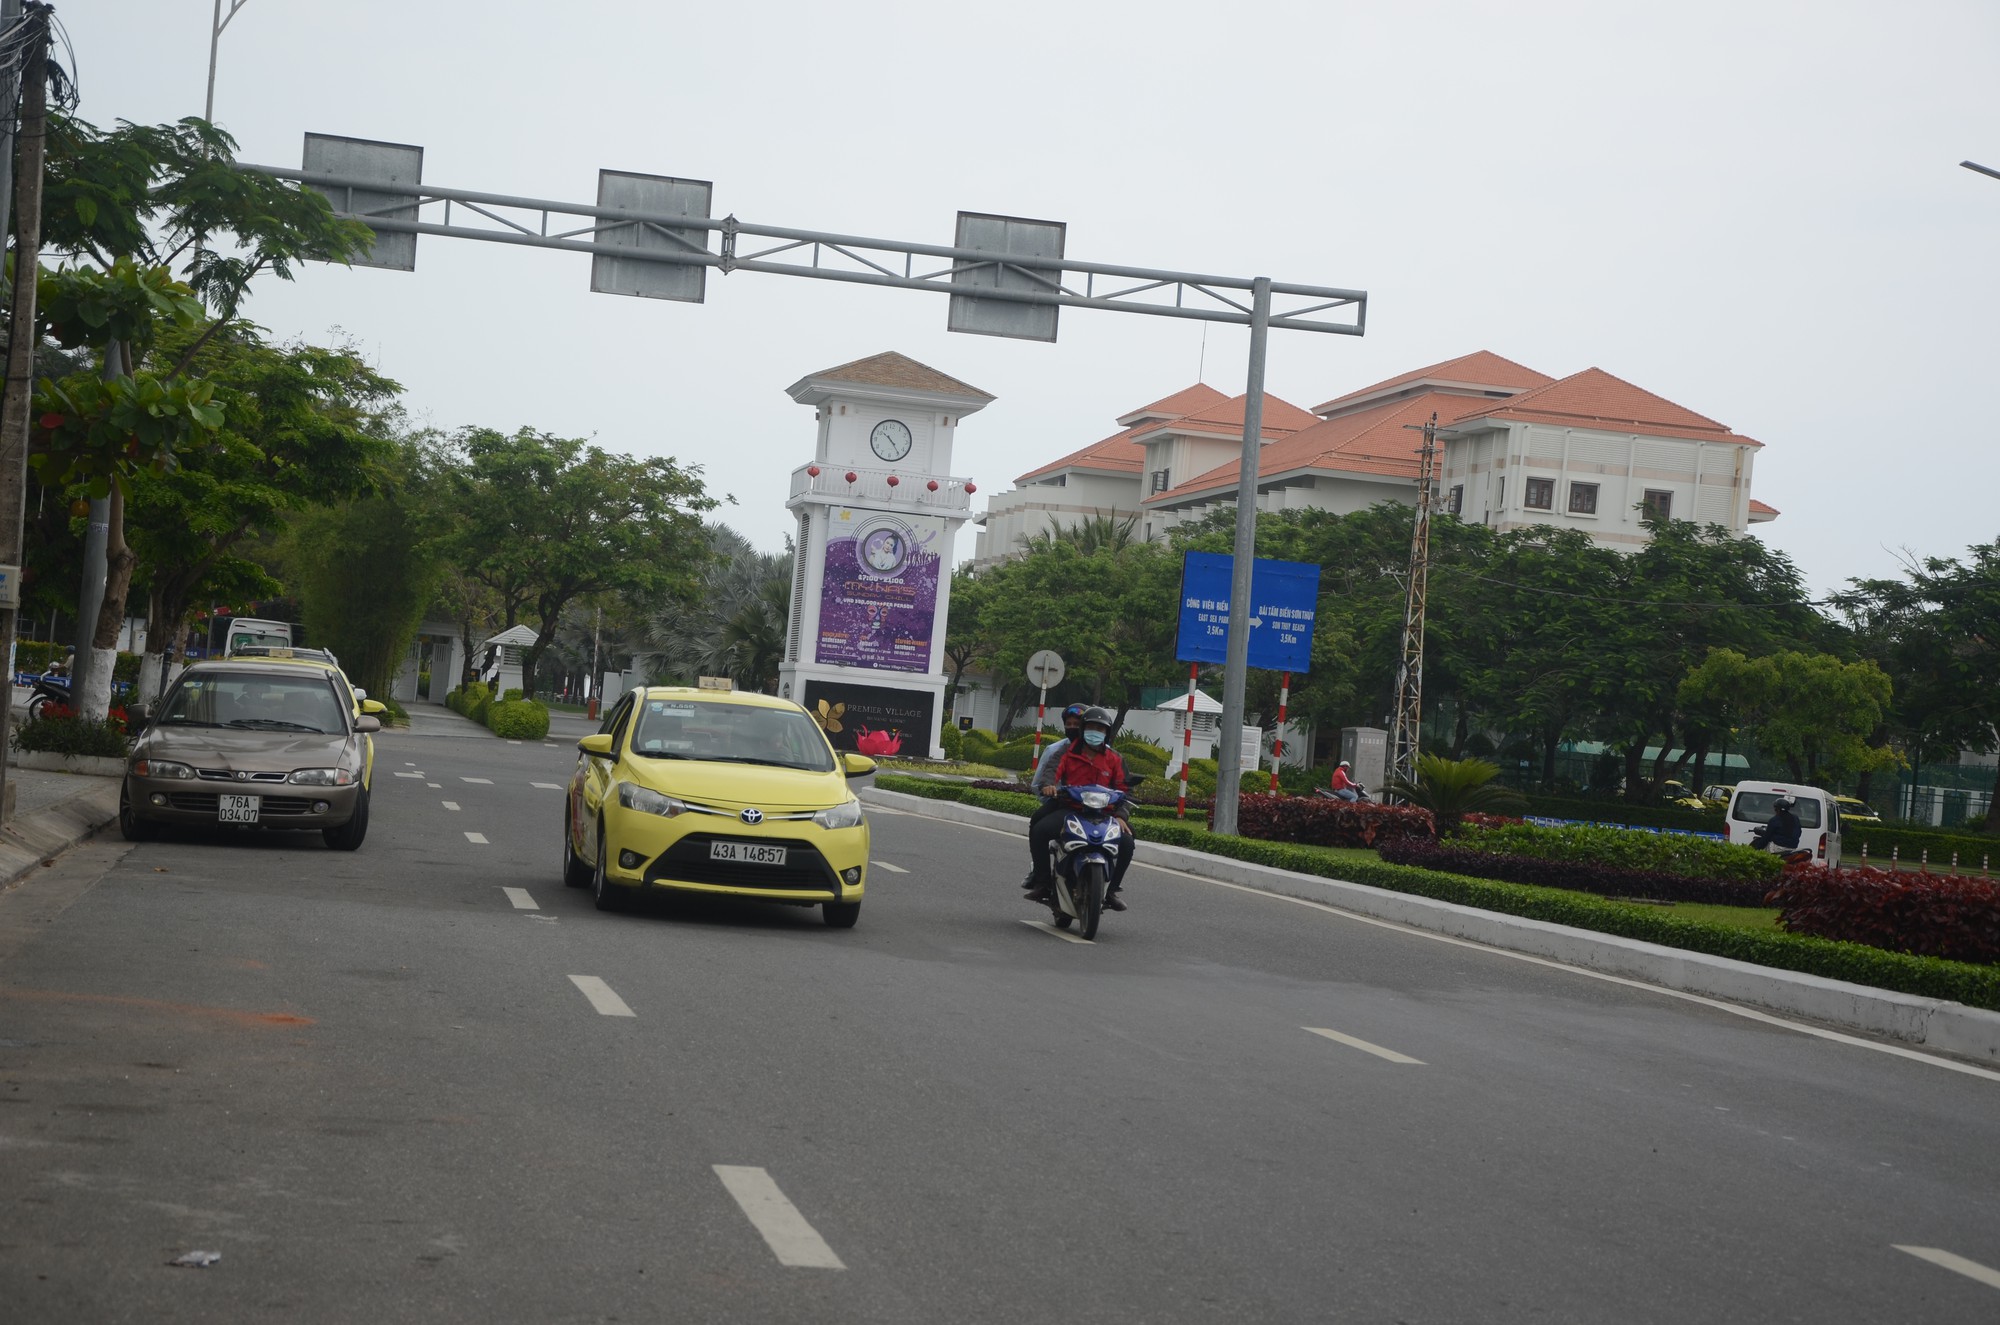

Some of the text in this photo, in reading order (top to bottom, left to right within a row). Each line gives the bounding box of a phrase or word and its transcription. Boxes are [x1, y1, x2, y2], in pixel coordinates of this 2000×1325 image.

[1198, 614, 1208, 622] EAST
[1209, 614, 1217, 623] SEA
[847, 704, 922, 718] PREMIER VILLAGE
[230, 796, 250, 808] 76A
[220, 809, 257, 821] 034.07
[713, 843, 784, 863] 43A 148.57
